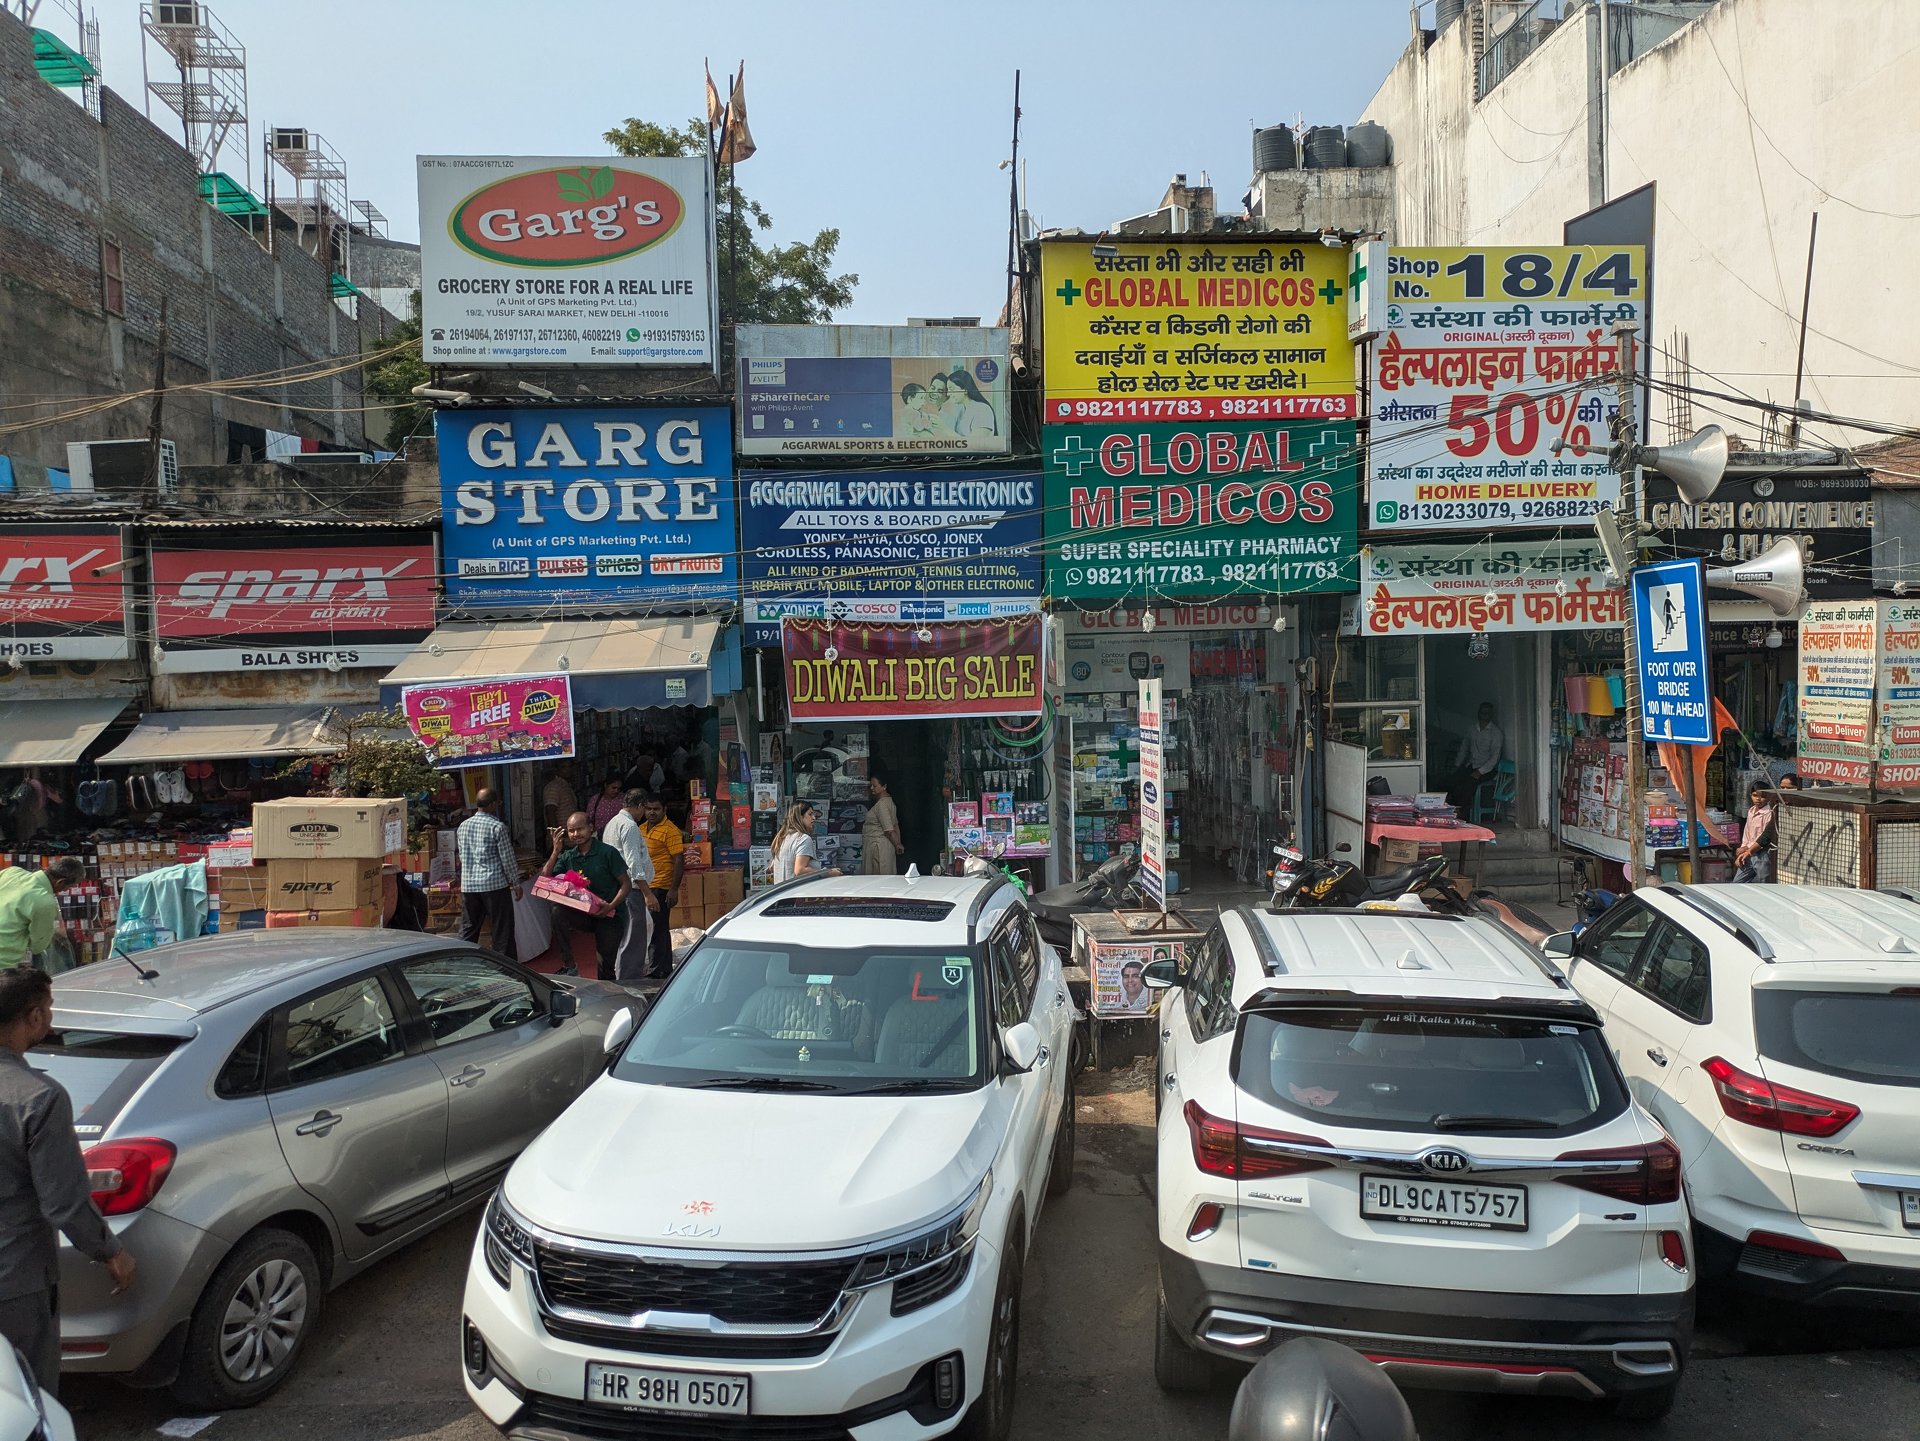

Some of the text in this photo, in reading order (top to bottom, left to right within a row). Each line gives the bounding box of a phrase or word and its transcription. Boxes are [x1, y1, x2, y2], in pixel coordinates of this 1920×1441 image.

[478, 196, 662, 243] Garg's
[1093, 248, 1305, 274] सस्ता भी और सही भी
[1388, 256, 1439, 277] Shop
[1447, 253, 1638, 298] 18/4
[438, 279, 693, 295] GROCERY STORE FOR A REAL LIFE
[1085, 277, 1315, 308] GLOBAL MEDICOS
[1394, 281, 1430, 298] No.
[509, 298, 526, 306] Unit
[558, 298, 598, 308] Marketing
[588, 310, 608, 318] NEW
[610, 310, 636, 318] DELHI
[1410, 306, 1486, 328] संस्था
[1493, 304, 1533, 328] की
[1089, 314, 1311, 335] केंसर किडनी रोगो की
[493, 329, 536, 343] 26197137,
[538, 329, 580, 343] 26712360,
[582, 329, 621, 341] 46082219
[643, 329, 705, 342] +919315793153
[433, 347, 567, 357] Shop www.gargstore.com
[591, 347, 703, 358] E-mail: support@gargstore.com
[1175, 343, 1258, 366] सर्जिकल
[1264, 348, 1327, 364] सामान
[1378, 329, 1527, 391] हैल्पलाइन
[1097, 370, 1240, 393] होल सेल रेट पर
[750, 392, 830, 402] #ShareTheCare
[751, 404, 766, 412] with
[768, 404, 791, 412] Philips
[1076, 398, 1346, 417] 9821117783 9821117763
[1446, 392, 1591, 458] 50%
[467, 420, 703, 468] GARG
[782, 440, 968, 450] AGGARWAL SPORTS ELECTRONICS
[1100, 430, 1304, 477] GLOBAL
[1552, 460, 1577, 476] सेवा
[750, 481, 1034, 509] AGGARWAL SPORTS ELECTRONICS
[1418, 482, 1594, 500] HOME DELIVERY
[456, 478, 719, 525] STORE
[1070, 481, 1335, 529] MEDICOS
[796, 514, 942, 526] ALL TOYS BOARD
[1399, 502, 1516, 522] 8130233079,
[1652, 501, 1875, 529] GANESH CONVENIENCE
[508, 534, 691, 547] Unit GPS Marketing Pvt. Ltd.)
[896, 533, 983, 546] COSCO, JONEX
[834, 546, 920, 560] PANASONIC,
[1060, 536, 1341, 560] SUPER SPECIALITY PHARMACY
[464, 560, 526, 574] Deals RICE
[539, 559, 584, 574] PULSES
[598, 558, 640, 572] SPICES
[652, 556, 720, 571] DRY FRUITS
[767, 566, 1020, 578] ALL KIND TENNIS GUTTING,
[1087, 561, 1338, 585] 9821117783 9821117763
[1736, 572, 1772, 580] KAMAL
[172, 558, 419, 618] sparx
[868, 579, 1034, 591] LAPTOP OTHER ELECTRONIC
[1433, 580, 1488, 588] ORIGINAL
[336, 607, 371, 618] FOR
[783, 605, 820, 617] YONEX
[855, 604, 896, 613] COSCO
[958, 603, 991, 615] beetel
[994, 604, 1031, 612] PHILIPS
[1836, 607, 1846, 621] की
[242, 653, 291, 666] BALA
[1648, 662, 1696, 676] FOOT OVER
[792, 654, 1035, 703] DIWALI BIG SALE
[1658, 682, 1690, 697] BRIDGE
[470, 692, 511, 728] BUY GET FREE
[524, 695, 556, 715] THIS DIWALI
[1648, 701, 1704, 718] 100 Mtr. AHEAD
[421, 717, 449, 728] DIWALI
[1810, 722, 1833, 735] Home
[1802, 760, 1850, 776] SHOP No.
[281, 881, 340, 894] sparx
[1383, 1014, 1476, 1026] Jai Kalka Mai
[1797, 1142, 1855, 1156] CRETA
[1431, 1154, 1462, 1169] KIA
[1365, 1184, 1520, 1218] IND DL9CAT5757
[603, 1373, 745, 1407] HR 98H 0507
